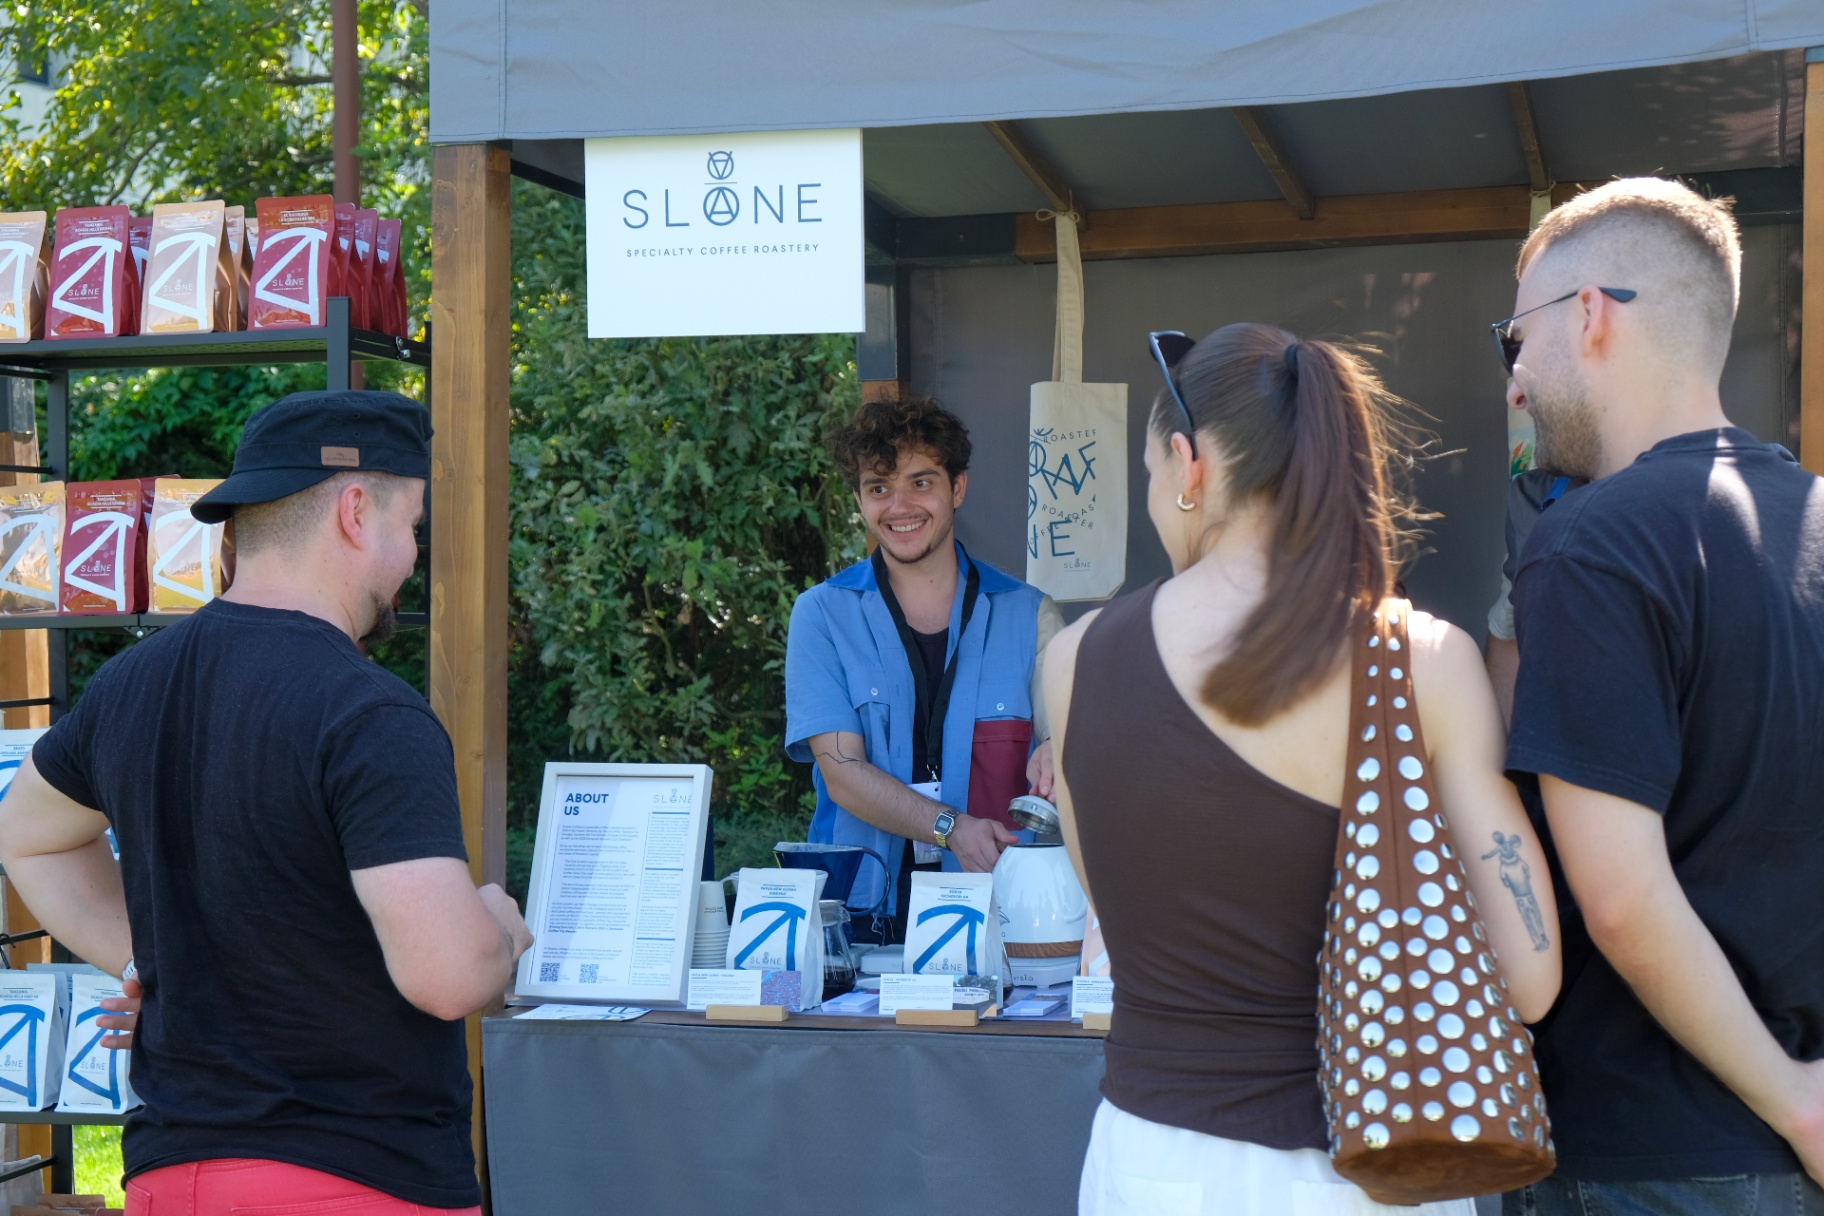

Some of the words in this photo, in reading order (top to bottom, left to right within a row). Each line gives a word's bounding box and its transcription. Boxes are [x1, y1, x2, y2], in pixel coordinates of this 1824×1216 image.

[626, 247, 694, 258] SPECIALTY
[700, 245, 747, 256] COFFEE
[753, 243, 819, 254] ROASTERY
[565, 793, 609, 804] ABOUT
[564, 806, 580, 816] US
